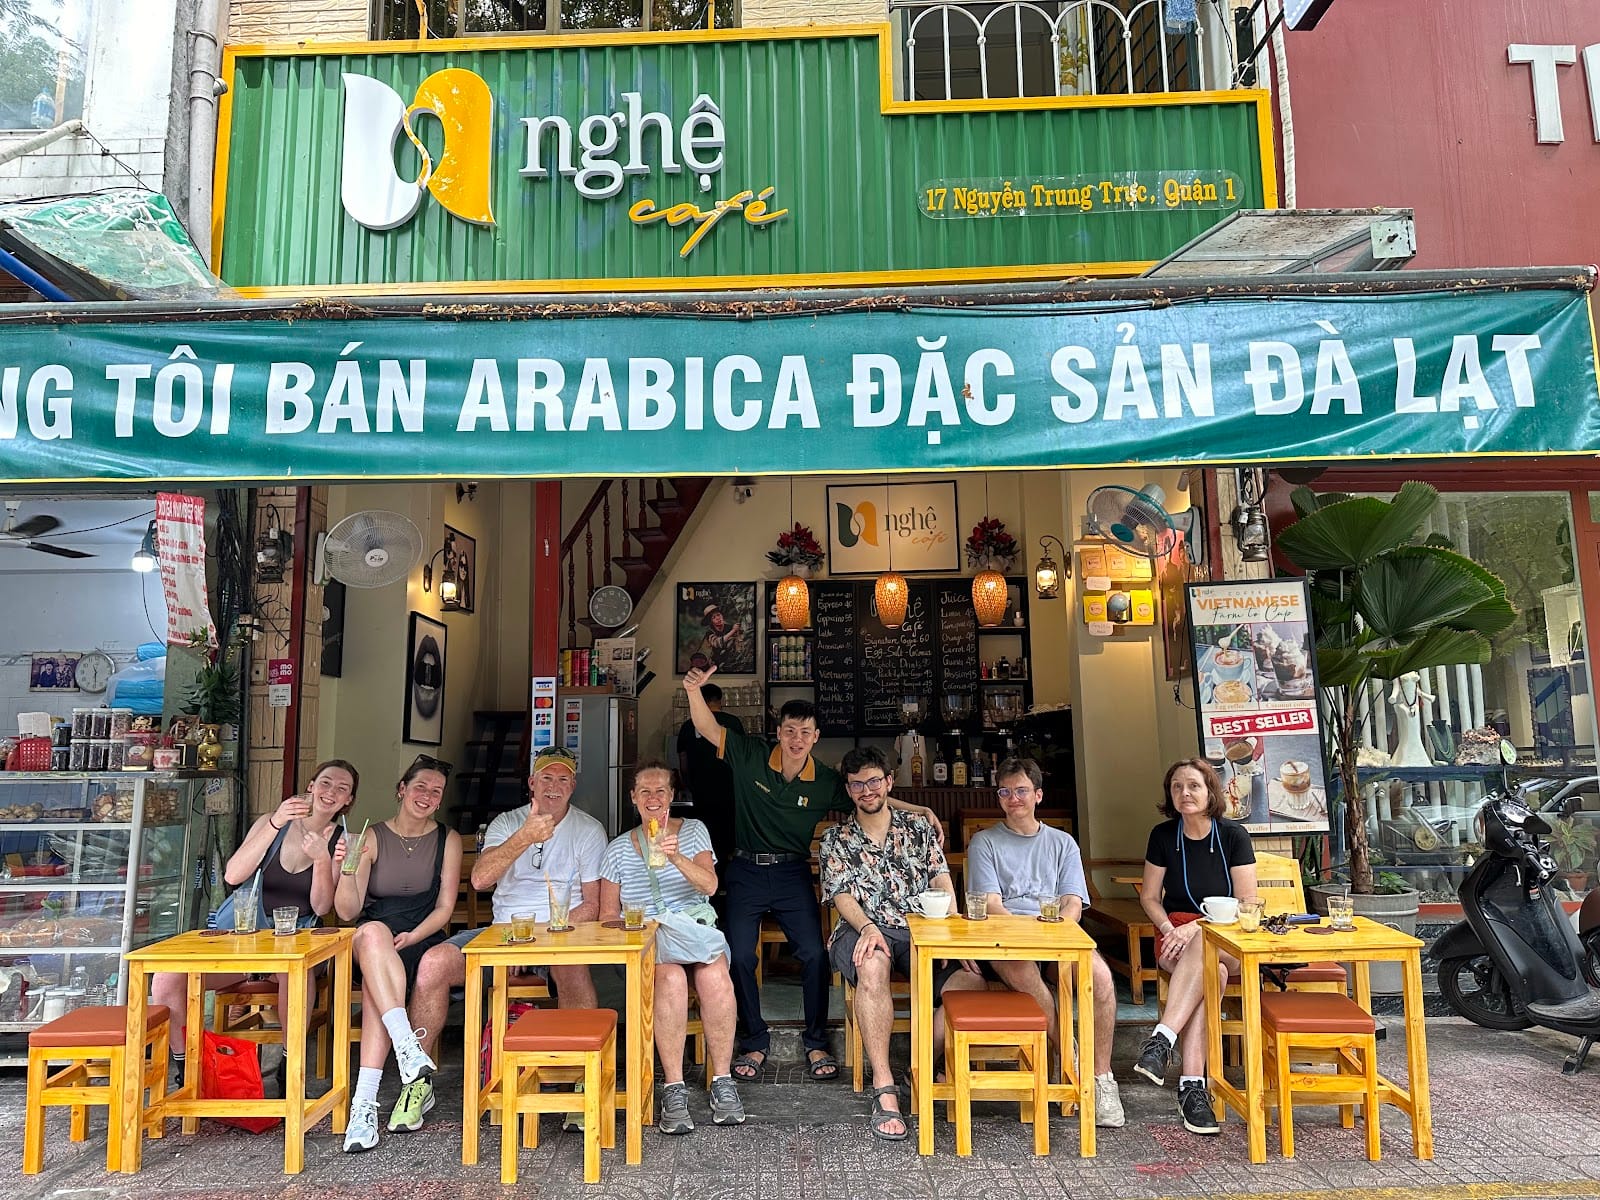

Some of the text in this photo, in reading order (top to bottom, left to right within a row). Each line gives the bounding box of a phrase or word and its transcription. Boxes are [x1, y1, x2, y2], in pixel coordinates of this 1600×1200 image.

[518, 92, 725, 199] nghệ
[926, 188, 947, 211] 17
[953, 181, 1026, 215] Nguyễn
[1031, 184, 1092, 211] Trung
[1164, 178, 1218, 208] Quận
[1225, 178, 1236, 200] 1
[628, 186, 788, 258] café
[105, 344, 235, 438] TÔI
[265, 341, 427, 435] BÁN
[456, 354, 821, 432] ARABICA
[846, 335, 1017, 445] ĐẶC
[1049, 322, 1215, 424] SẢN
[1244, 320, 1364, 416] ĐÀ
[1393, 334, 1543, 430] LẠT
[884, 506, 937, 538] nghệ
[940, 591, 969, 604] Juice
[1197, 595, 1299, 610] VIETNAMESE
[1265, 601, 1295, 622] Cup
[1212, 711, 1310, 735] BEST SELLER
